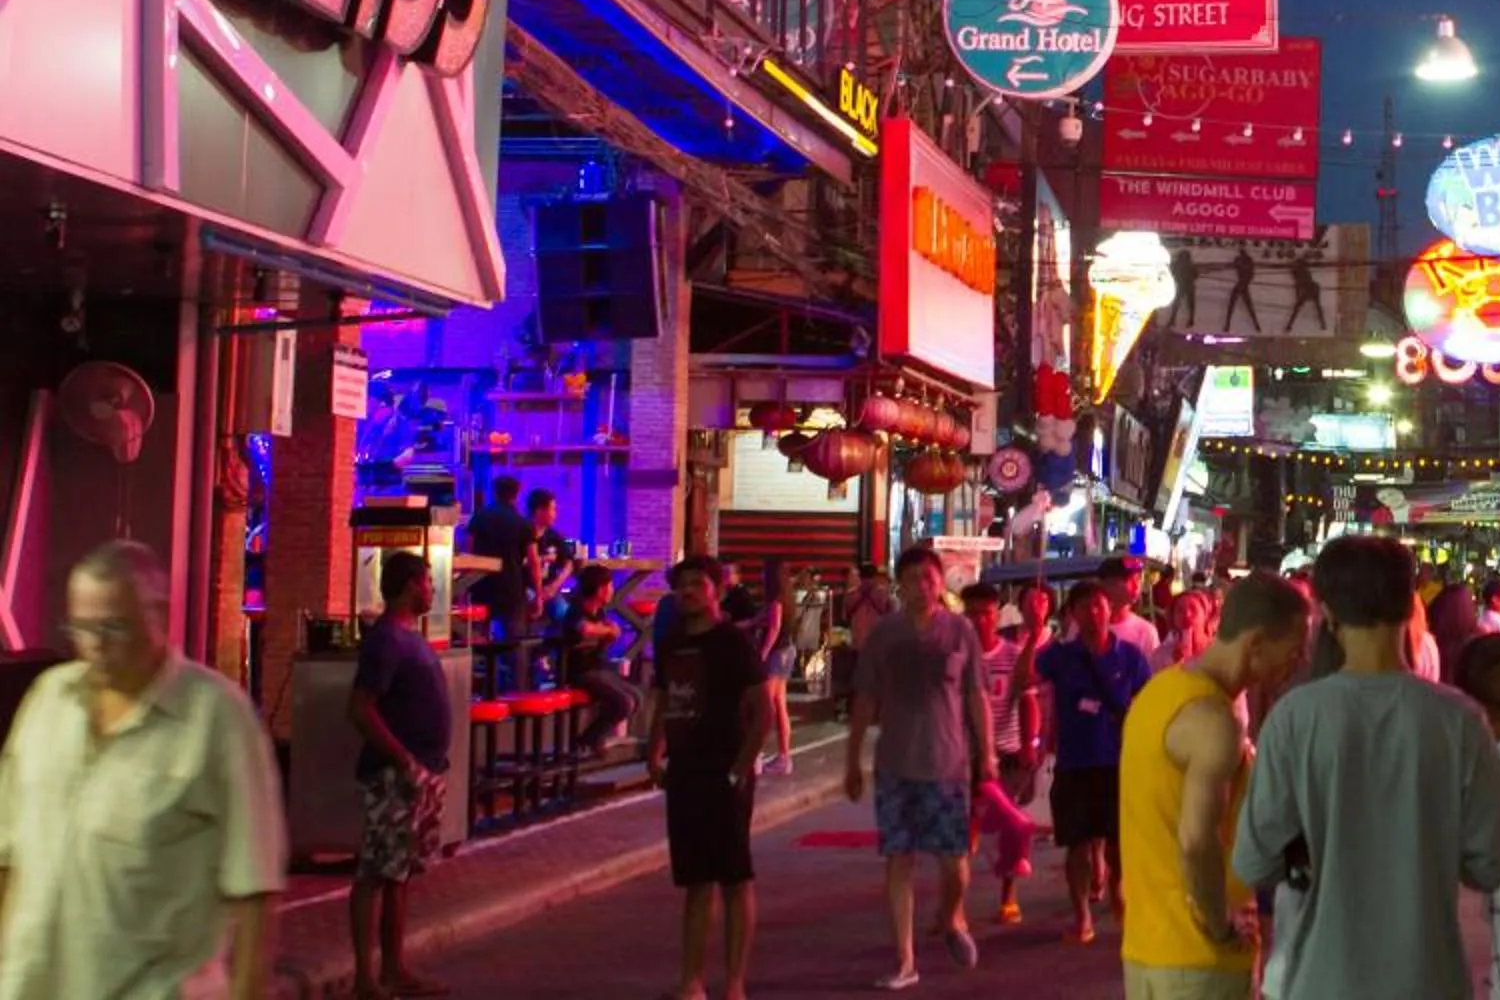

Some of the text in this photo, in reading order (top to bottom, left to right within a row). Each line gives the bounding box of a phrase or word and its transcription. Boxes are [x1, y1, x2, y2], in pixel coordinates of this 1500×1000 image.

[1153, 1, 1230, 27] STREET
[957, 26, 1101, 52] Grand Hotel
[1168, 64, 1314, 89] SUGARBABY
[840, 67, 879, 133] BLACK
[1117, 177, 1297, 201] THE WINDMILL CLUB
[1172, 201, 1240, 218] AGOGO
